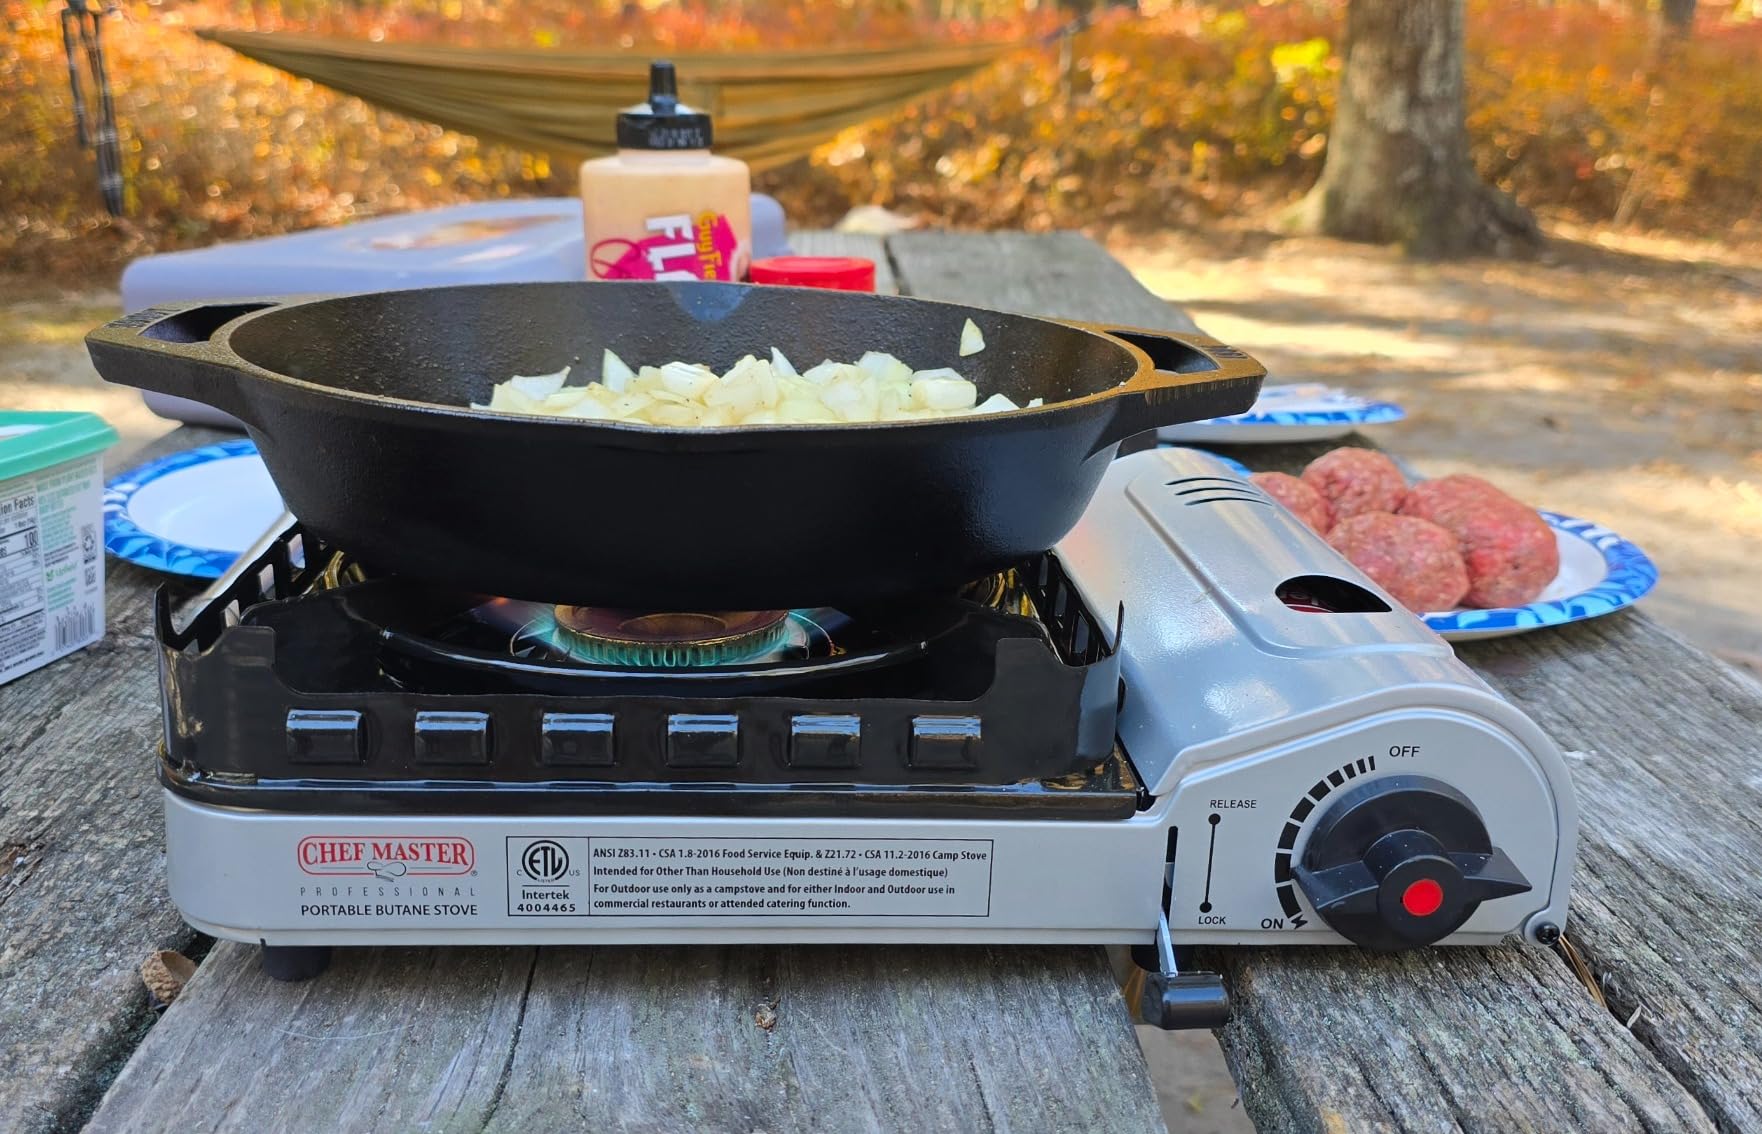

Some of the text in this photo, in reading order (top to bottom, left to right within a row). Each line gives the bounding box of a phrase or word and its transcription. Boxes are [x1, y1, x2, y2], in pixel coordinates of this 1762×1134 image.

[14, 495, 34, 511] Facts
[1388, 745, 1420, 758] OFF
[1209, 799, 1257, 809] RELEASE
[302, 841, 469, 867] CHEF MASTER
[593, 848, 987, 862] ANSI Z83.11 CSA 1.8-2016 Food Service Equip. & Z21.72 CSA 11.2-2016 Camp Stove
[528, 845, 563, 877] ETL
[516, 869, 523, 877] C
[568, 869, 581, 877] US
[593, 866, 638, 876] Intended
[639, 866, 654, 876] for
[656, 866, 684, 876] Other
[685, 866, 709, 876] Than
[711, 866, 762, 876] Household
[764, 867, 781, 877] Use
[783, 867, 806, 879] (Non
[807, 867, 843, 877] destiné
[845, 867, 851, 877] à
[888, 867, 949, 879] domestique)
[300, 886, 475, 897] PROFESSIONAL
[521, 889, 570, 900] Intertek
[593, 884, 610, 894] For
[611, 884, 651, 894] Outdoor
[671, 884, 692, 896] only
[714, 884, 766, 896] campstove
[767, 884, 786, 894] and
[787, 884, 802, 894] for
[803, 884, 833, 894] either
[834, 884, 866, 894] Indoor
[867, 884, 886, 894] and
[887, 884, 927, 894] Outdoor
[945, 884, 956, 894] in
[301, 904, 478, 916] PORTABLE BUTANE STOVE
[516, 903, 576, 912] 4004465
[593, 899, 649, 909] commercial
[651, 899, 707, 909] restaurants
[720, 899, 765, 909] attended
[766, 899, 806, 910] catering
[807, 899, 851, 909] function.
[1198, 915, 1227, 925] LOCK
[1260, 917, 1285, 930] ON
